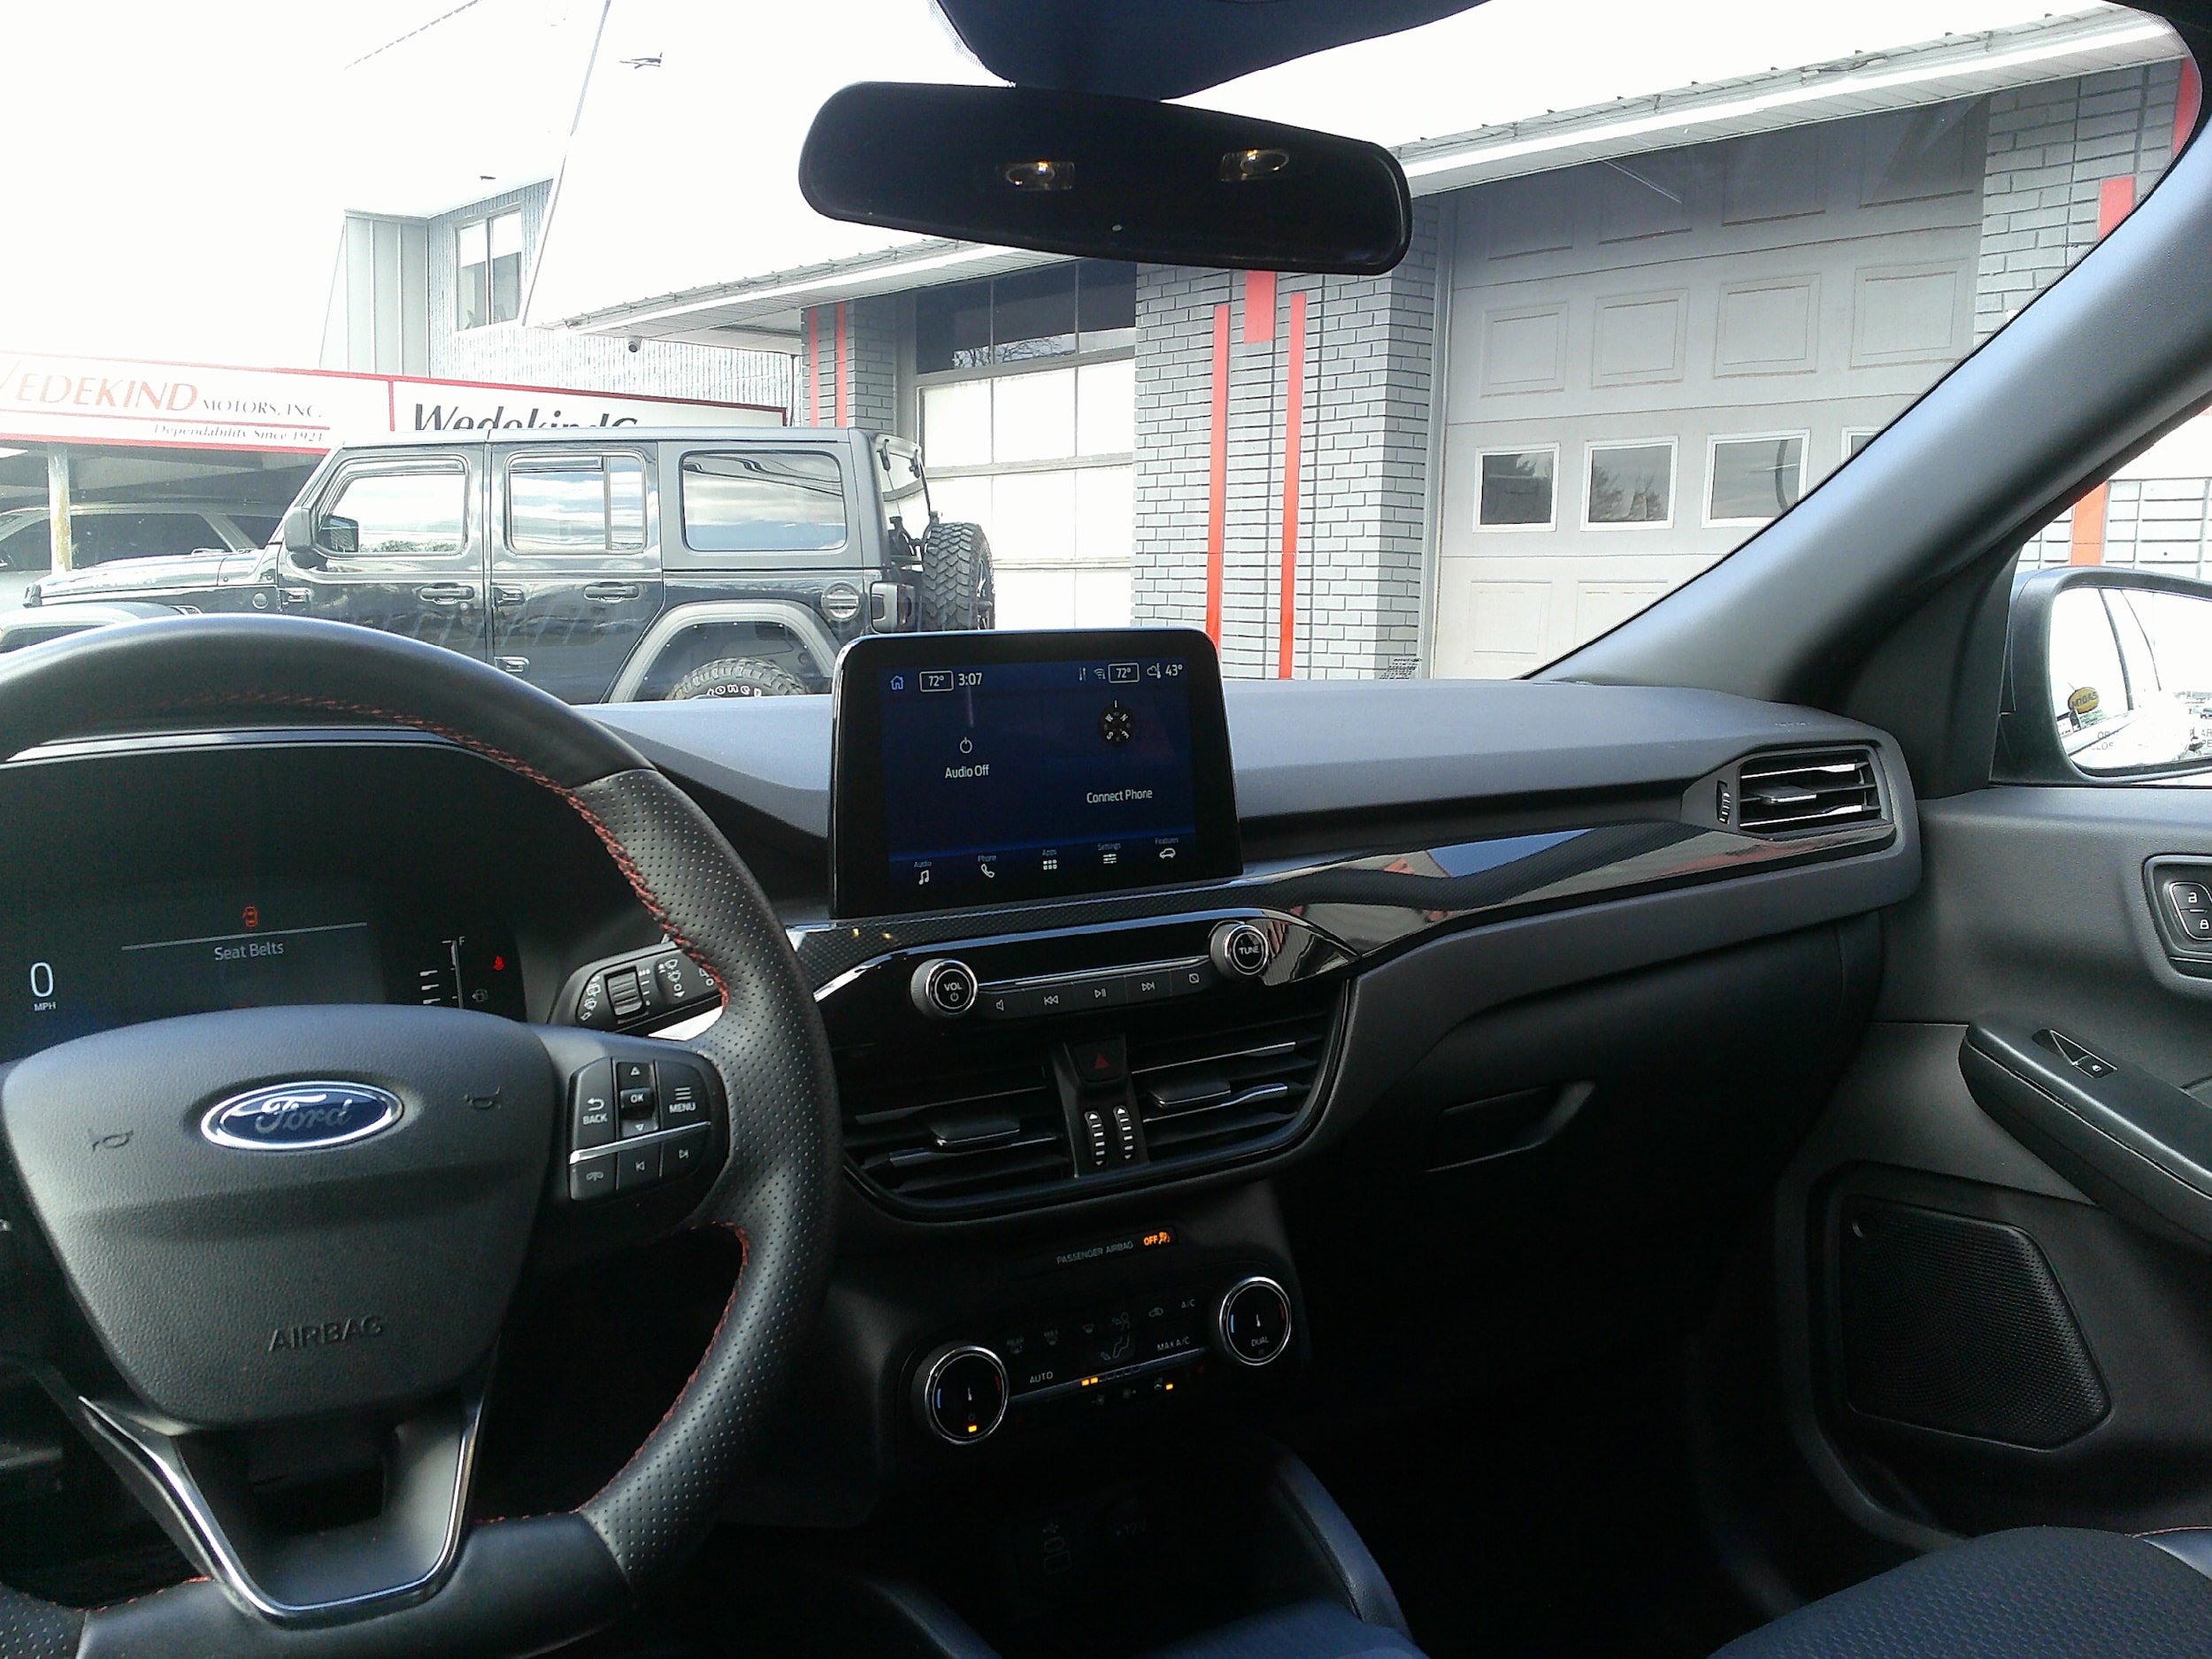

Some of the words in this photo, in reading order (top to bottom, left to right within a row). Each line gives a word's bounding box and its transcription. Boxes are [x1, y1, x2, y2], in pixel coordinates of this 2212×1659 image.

[254, 429, 288, 441] Since
[1164, 664, 1184, 677] 43°
[957, 672, 982, 687] 3:07
[945, 765, 972, 779] Audio
[974, 764, 990, 777] Off
[1087, 789, 1124, 803] Connect
[1125, 787, 1153, 802] Phone
[913, 859, 933, 869] Audio
[978, 854, 997, 863] Phone
[214, 943, 246, 961] Seat
[249, 941, 284, 957] Belts
[1239, 946, 1260, 956] TUNE
[30, 961, 54, 998] 0
[943, 982, 963, 992] VOL
[34, 1001, 57, 1012] MPH
[630, 1094, 644, 1103] OK
[229, 1094, 353, 1134] Ford
[669, 1102, 696, 1114] MENU
[582, 1113, 608, 1125] BACK
[1056, 1247, 1103, 1264] PASSENGER
[1106, 1240, 1134, 1254] AIRBAG
[1143, 1234, 1158, 1247] OFF
[1180, 1298, 1196, 1309] A/C
[268, 1316, 383, 1352] AIRBAG
[1156, 1341, 1174, 1352] MAX
[1175, 1336, 1191, 1348] A/C
[1250, 1336, 1270, 1348] DUAL
[1029, 1370, 1054, 1384] AUTO
